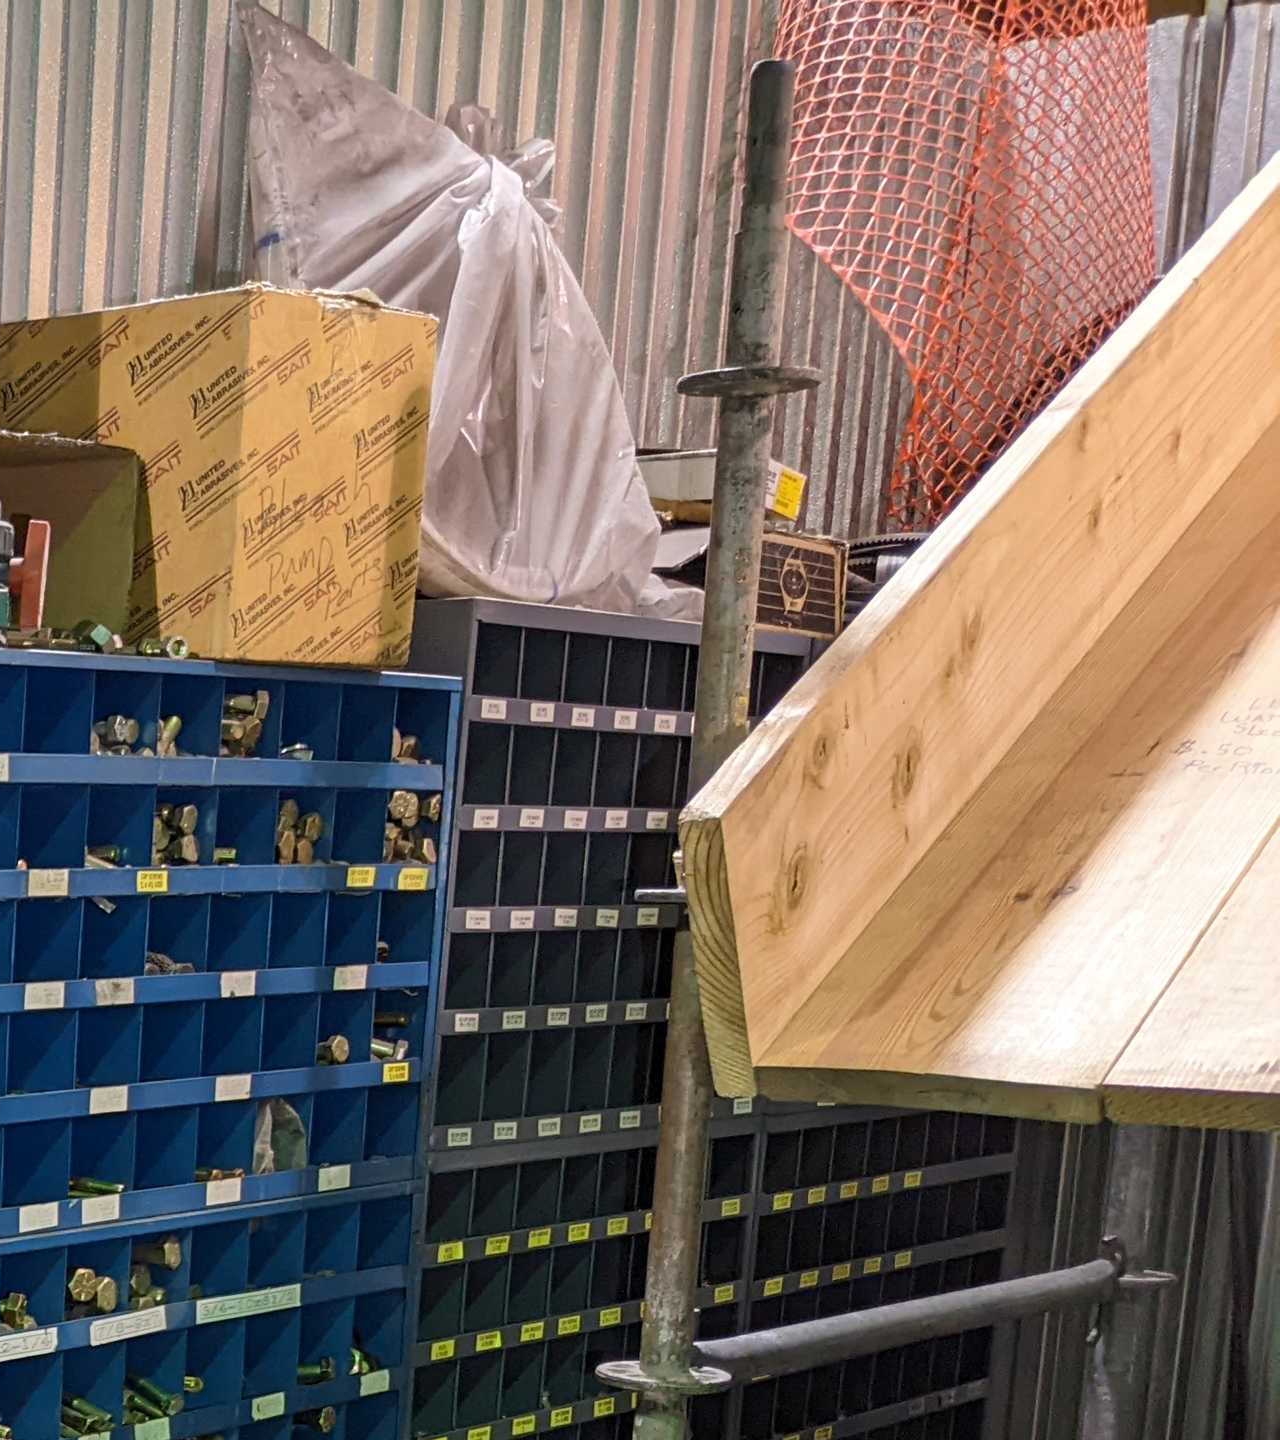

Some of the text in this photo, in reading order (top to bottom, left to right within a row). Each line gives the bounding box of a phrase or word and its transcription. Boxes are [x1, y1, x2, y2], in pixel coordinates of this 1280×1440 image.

[87, 324, 130, 370] SAIT
[143, 332, 173, 362] UNITED
[206, 365, 237, 394] UNITED
[276, 349, 312, 386] SAIT
[381, 352, 416, 390] SAIT
[195, 459, 226, 487] UNITED
[266, 439, 301, 478] SAIT
